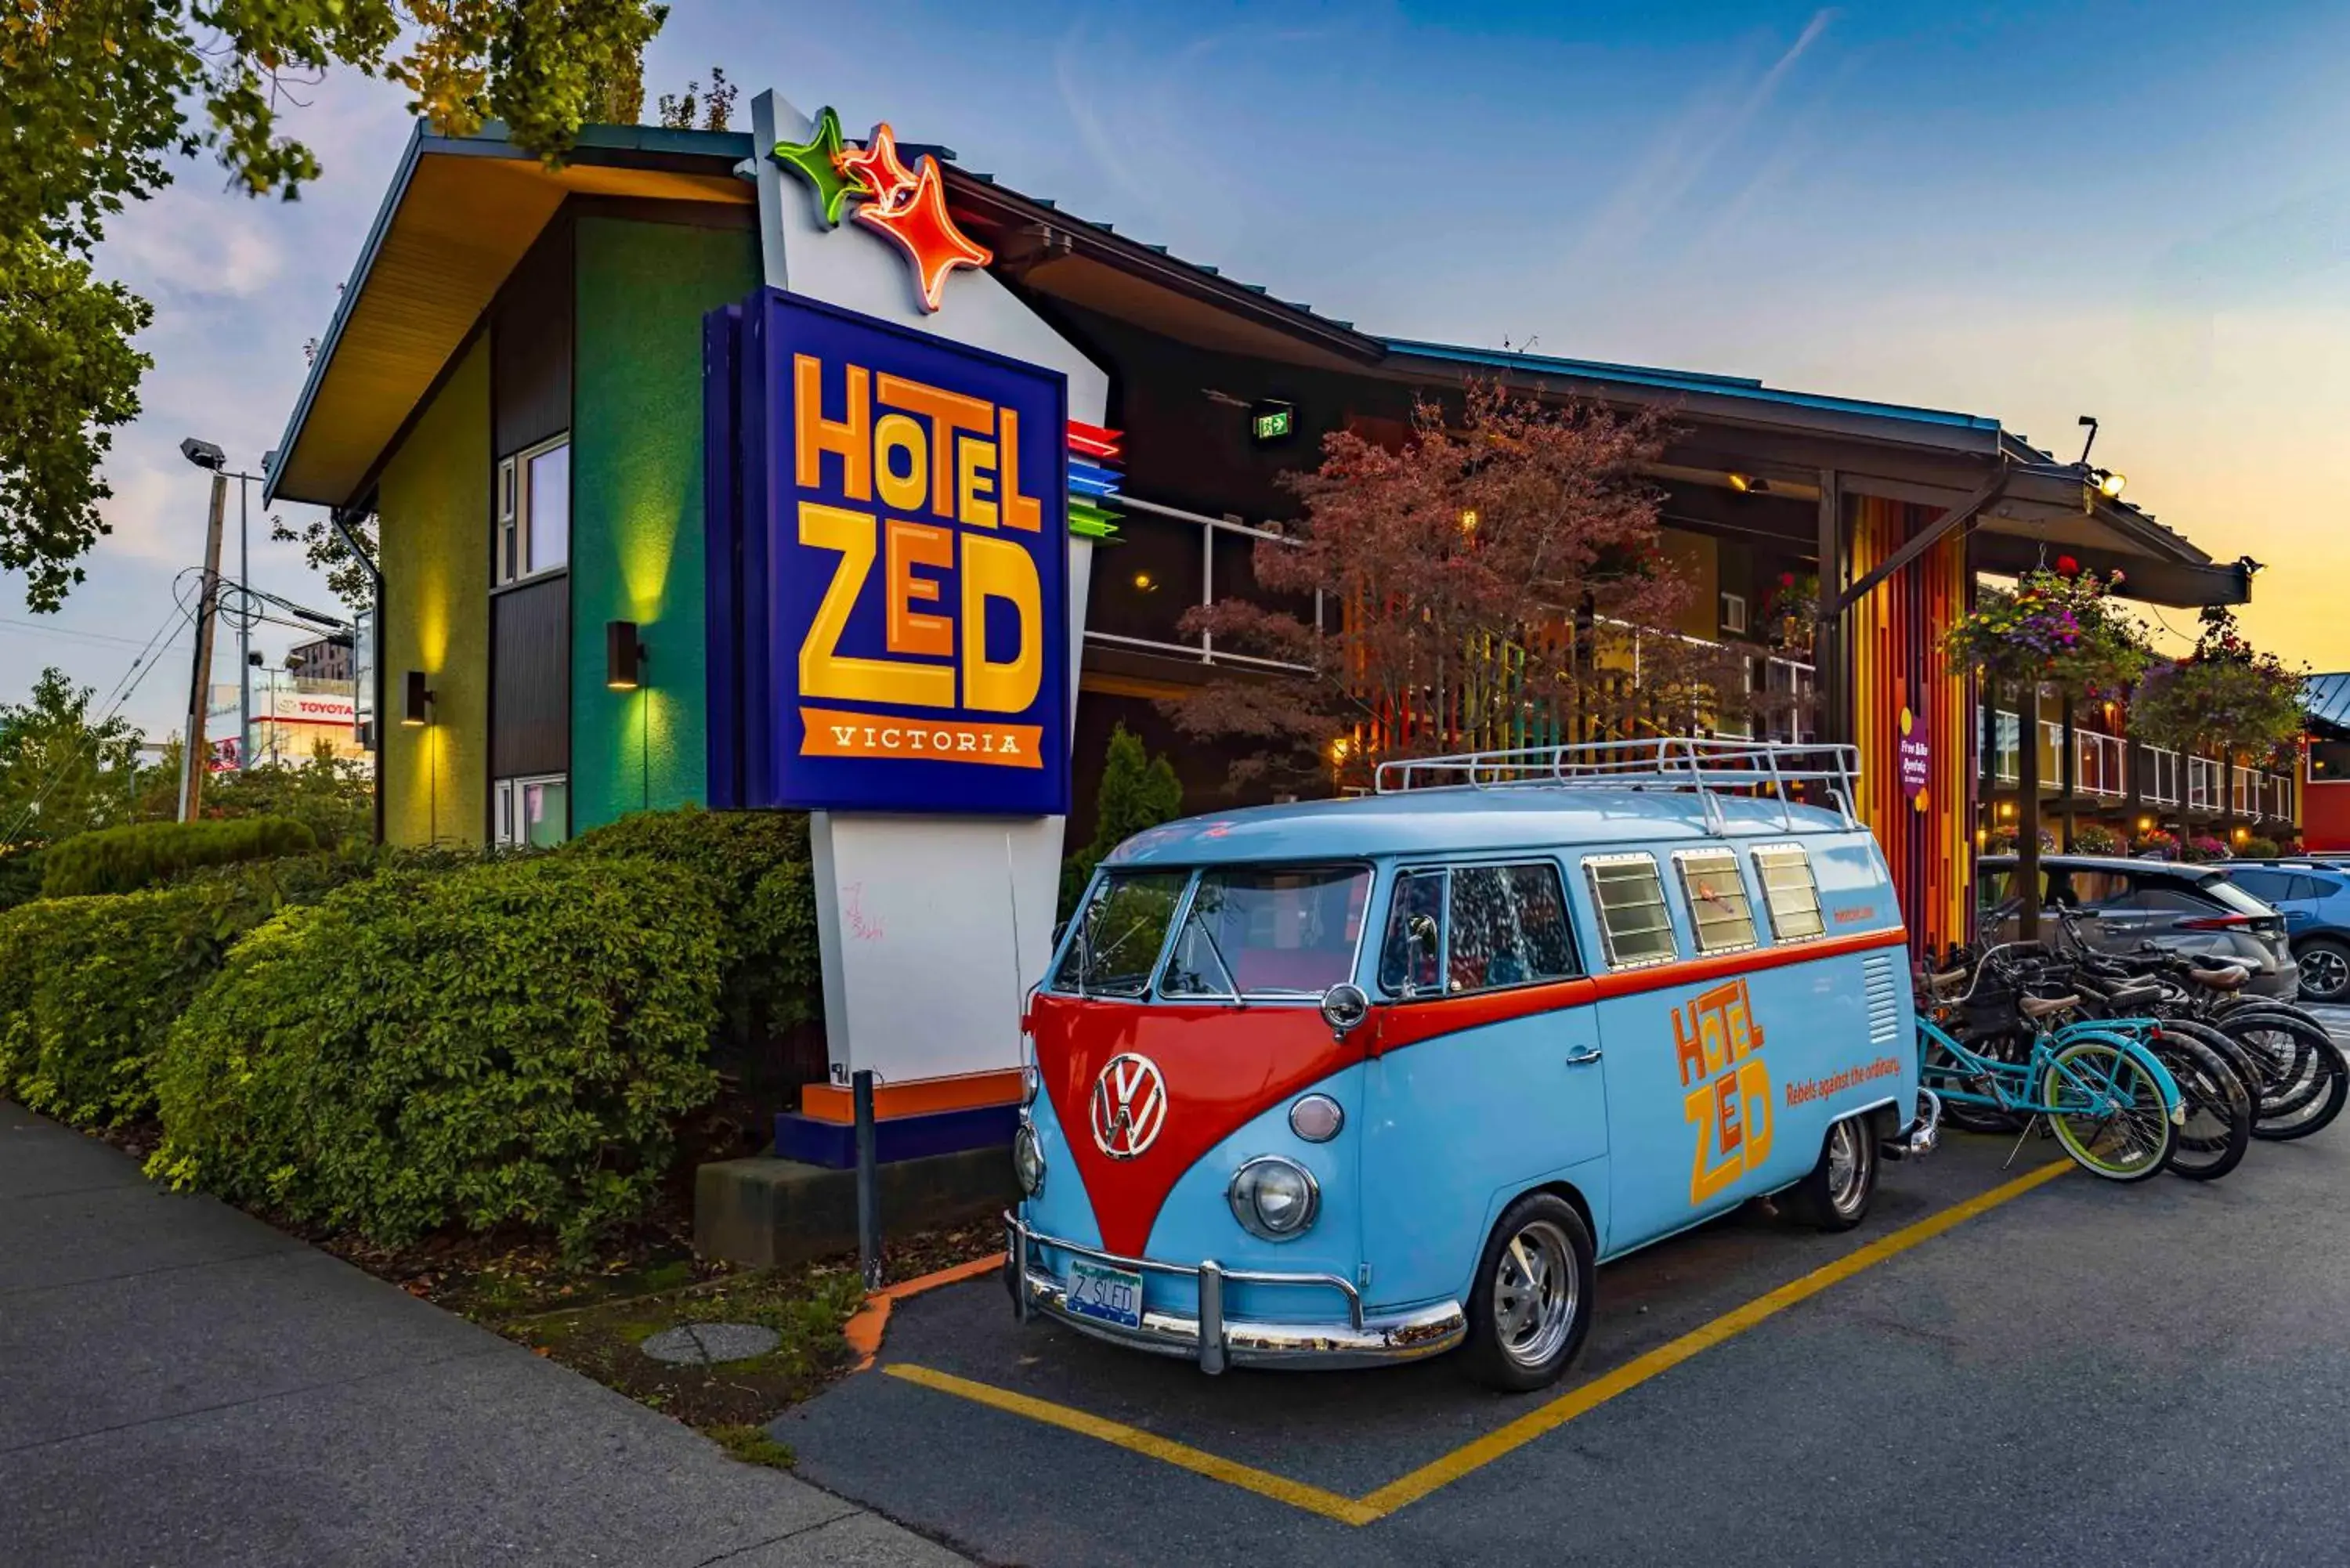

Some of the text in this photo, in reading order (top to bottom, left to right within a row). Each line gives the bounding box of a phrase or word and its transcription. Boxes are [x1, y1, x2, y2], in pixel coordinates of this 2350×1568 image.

[794, 353, 1041, 533] HOTEL
[797, 500, 1043, 713] ZED
[299, 702, 353, 715] TOYOTA
[830, 725, 1021, 754] VICTORIA
[1671, 977, 1764, 1086] HOTEL
[1786, 1078, 1816, 1107] Rebels
[1818, 1071, 1849, 1101] against
[1851, 1066, 1864, 1086] the
[1684, 1059, 1773, 1206] ZED
[1074, 1275, 1131, 1311] Z SLED
